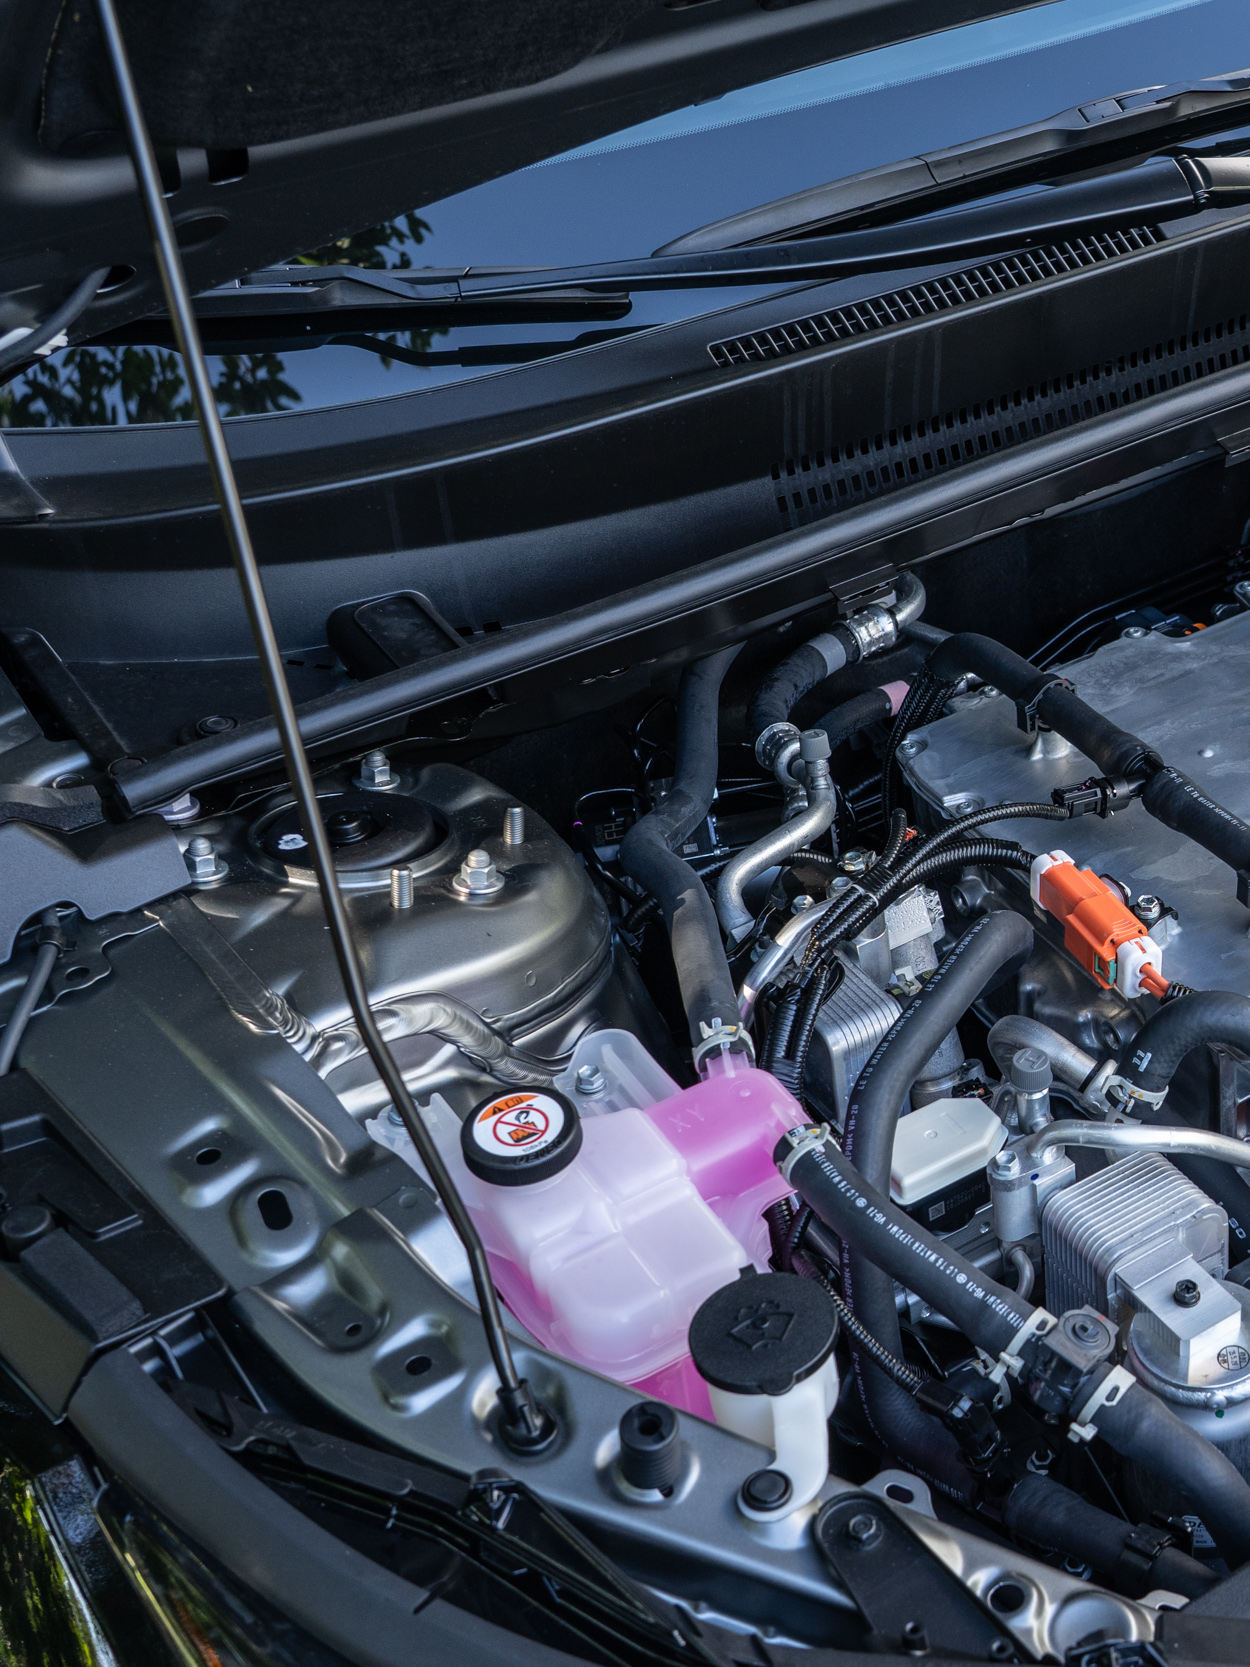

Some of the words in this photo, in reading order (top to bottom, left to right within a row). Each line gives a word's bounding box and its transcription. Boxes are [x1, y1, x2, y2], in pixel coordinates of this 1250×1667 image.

[1184, 785, 1194, 794] LE
[1198, 796, 1216, 809] WATER
[924, 983, 935, 992] LE
[939, 954, 958, 975] WATER
[955, 934, 975, 955] >EPDM<
[857, 1078, 867, 1090] LE
[869, 1042, 890, 1065] WATER
[887, 1017, 907, 1041] >EPDM<
[820, 1161, 843, 1184] WATER
[886, 1223, 915, 1247] >EPDM<
[912, 1241, 941, 1264] WATER
